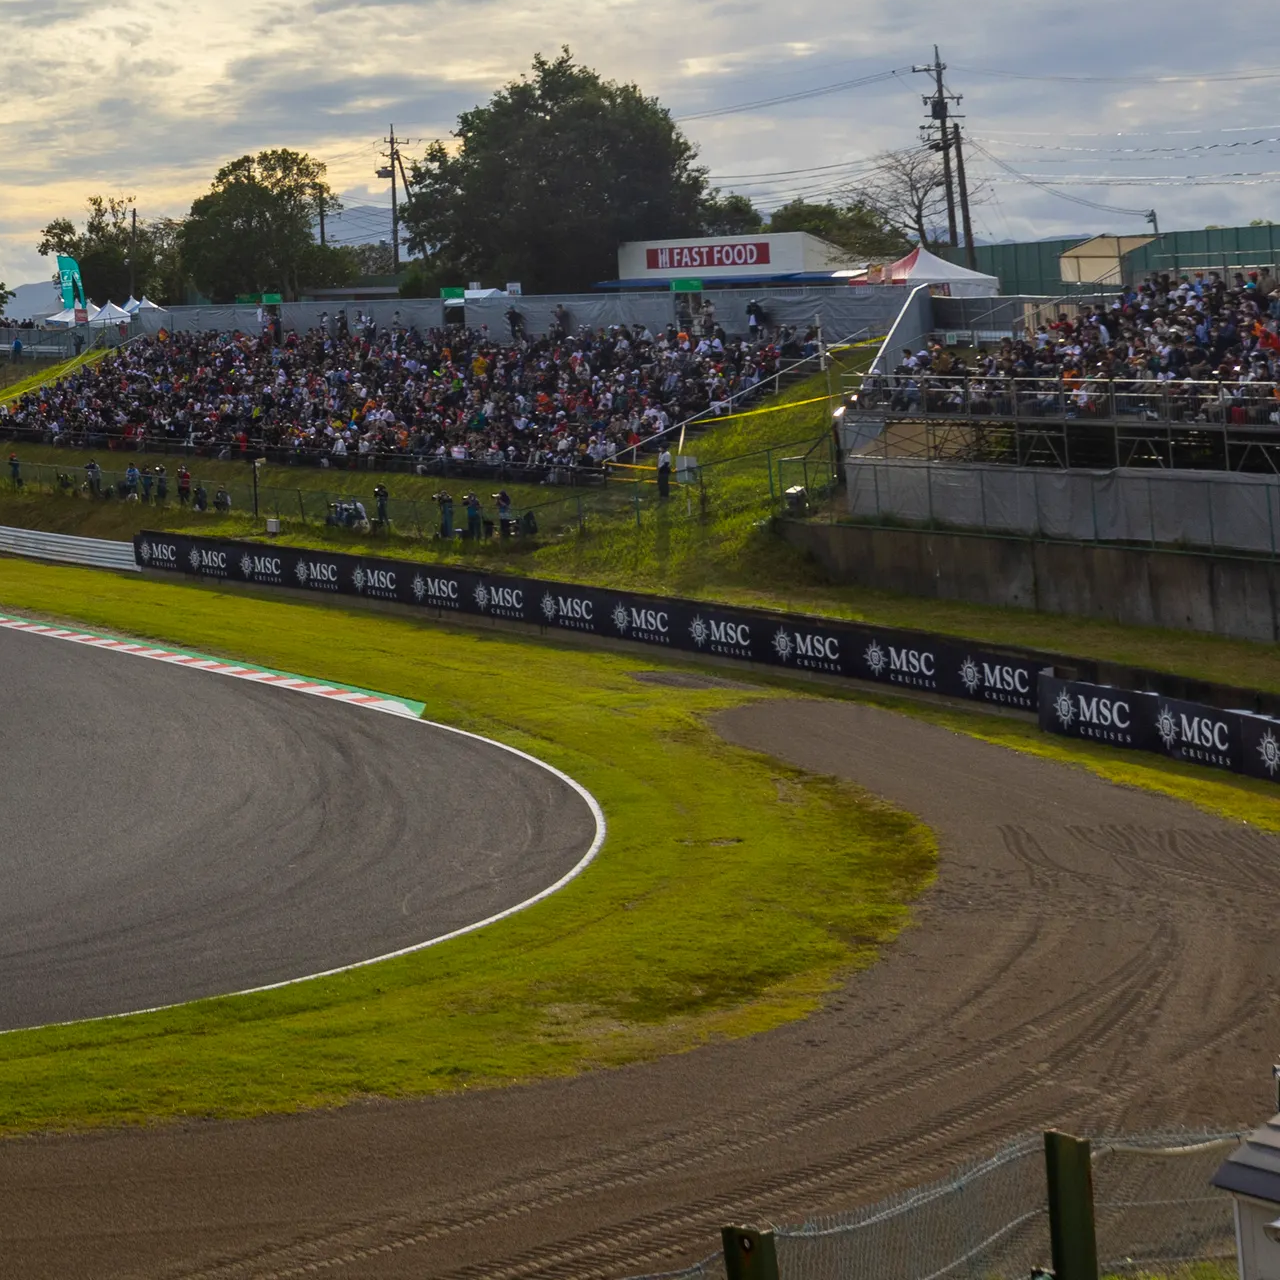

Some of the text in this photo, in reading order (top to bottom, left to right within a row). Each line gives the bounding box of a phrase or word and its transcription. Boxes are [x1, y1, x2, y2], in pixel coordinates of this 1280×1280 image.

[673, 244, 757, 267] FAST FOOD
[151, 543, 176, 560] MSC
[201, 550, 226, 568] MSC
[254, 556, 281, 574] MSC
[309, 562, 337, 581] MSC
[367, 569, 396, 589] MSC
[426, 578, 458, 598] MSC
[368, 589, 397, 598] CRUISES
[428, 598, 459, 608] CRUISES
[490, 586, 523, 608] MSC
[491, 607, 524, 618] CRUISES
[558, 596, 593, 619] MSC
[560, 619, 594, 630] CRUISES
[630, 608, 668, 632] MSC
[632, 631, 669, 643] CRUISES
[709, 620, 750, 645] MSC
[711, 644, 752, 657] CRUISES
[794, 632, 839, 659] MSC
[797, 658, 841, 671] CRUISES
[888, 646, 934, 675] MSC
[890, 673, 936, 688] CRUISES
[982, 663, 1029, 693] MSC
[984, 691, 1031, 707] CRUISES
[1078, 695, 1130, 728] MSC
[1080, 726, 1132, 743] CRUISES
[1180, 713, 1229, 751] MSC
[1181, 747, 1231, 766] CRUISES
